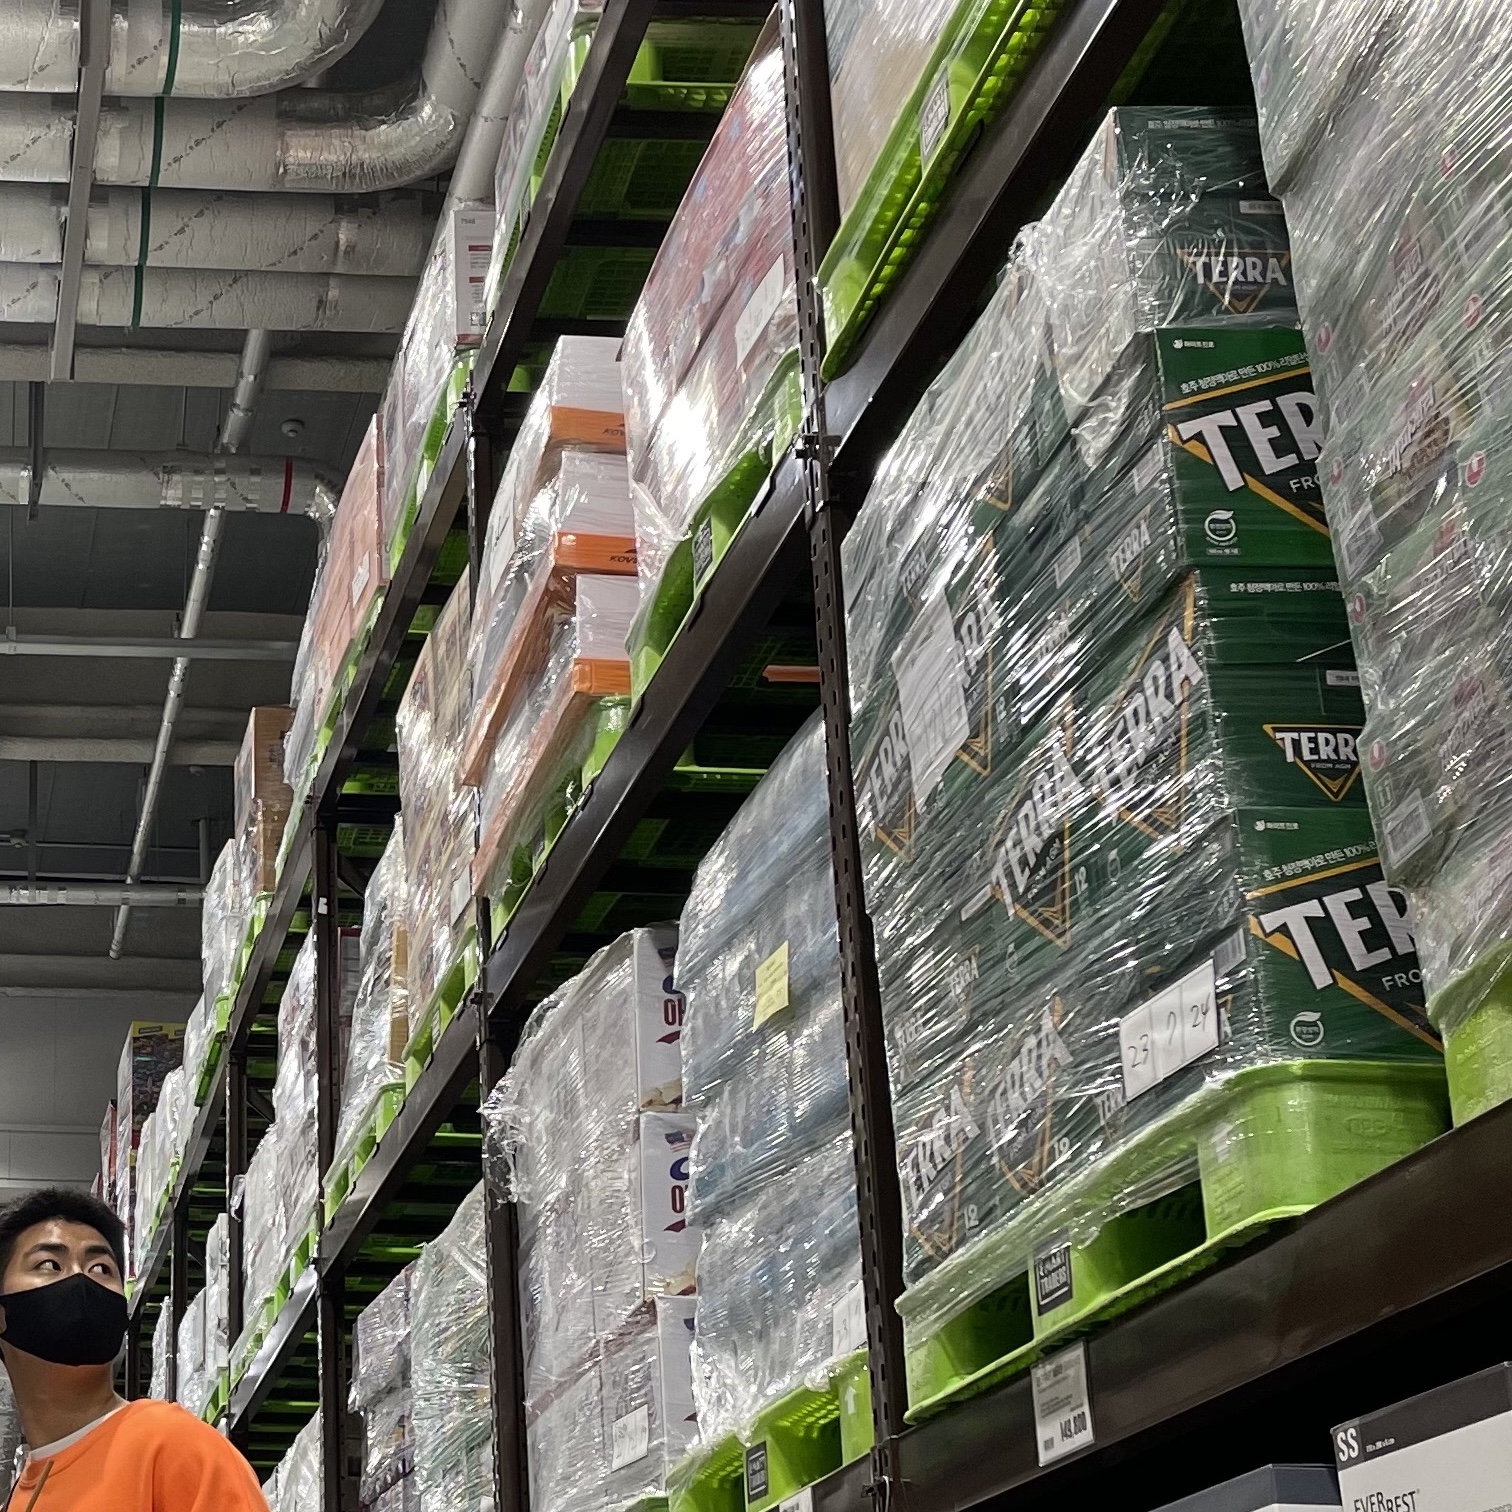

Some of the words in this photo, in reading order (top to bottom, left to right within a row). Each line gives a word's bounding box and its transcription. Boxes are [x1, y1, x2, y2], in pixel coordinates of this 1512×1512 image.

[1189, 254, 1287, 287] TERRA
[1180, 381, 1198, 394] 호주
[1255, 360, 1281, 373] 100%
[1275, 732, 1358, 762] TERR
[1262, 866, 1283, 881] 호주
[1324, 849, 1346, 864] 만든
[1343, 844, 1371, 857] 100%
[1337, 1427, 1359, 1461] SS
